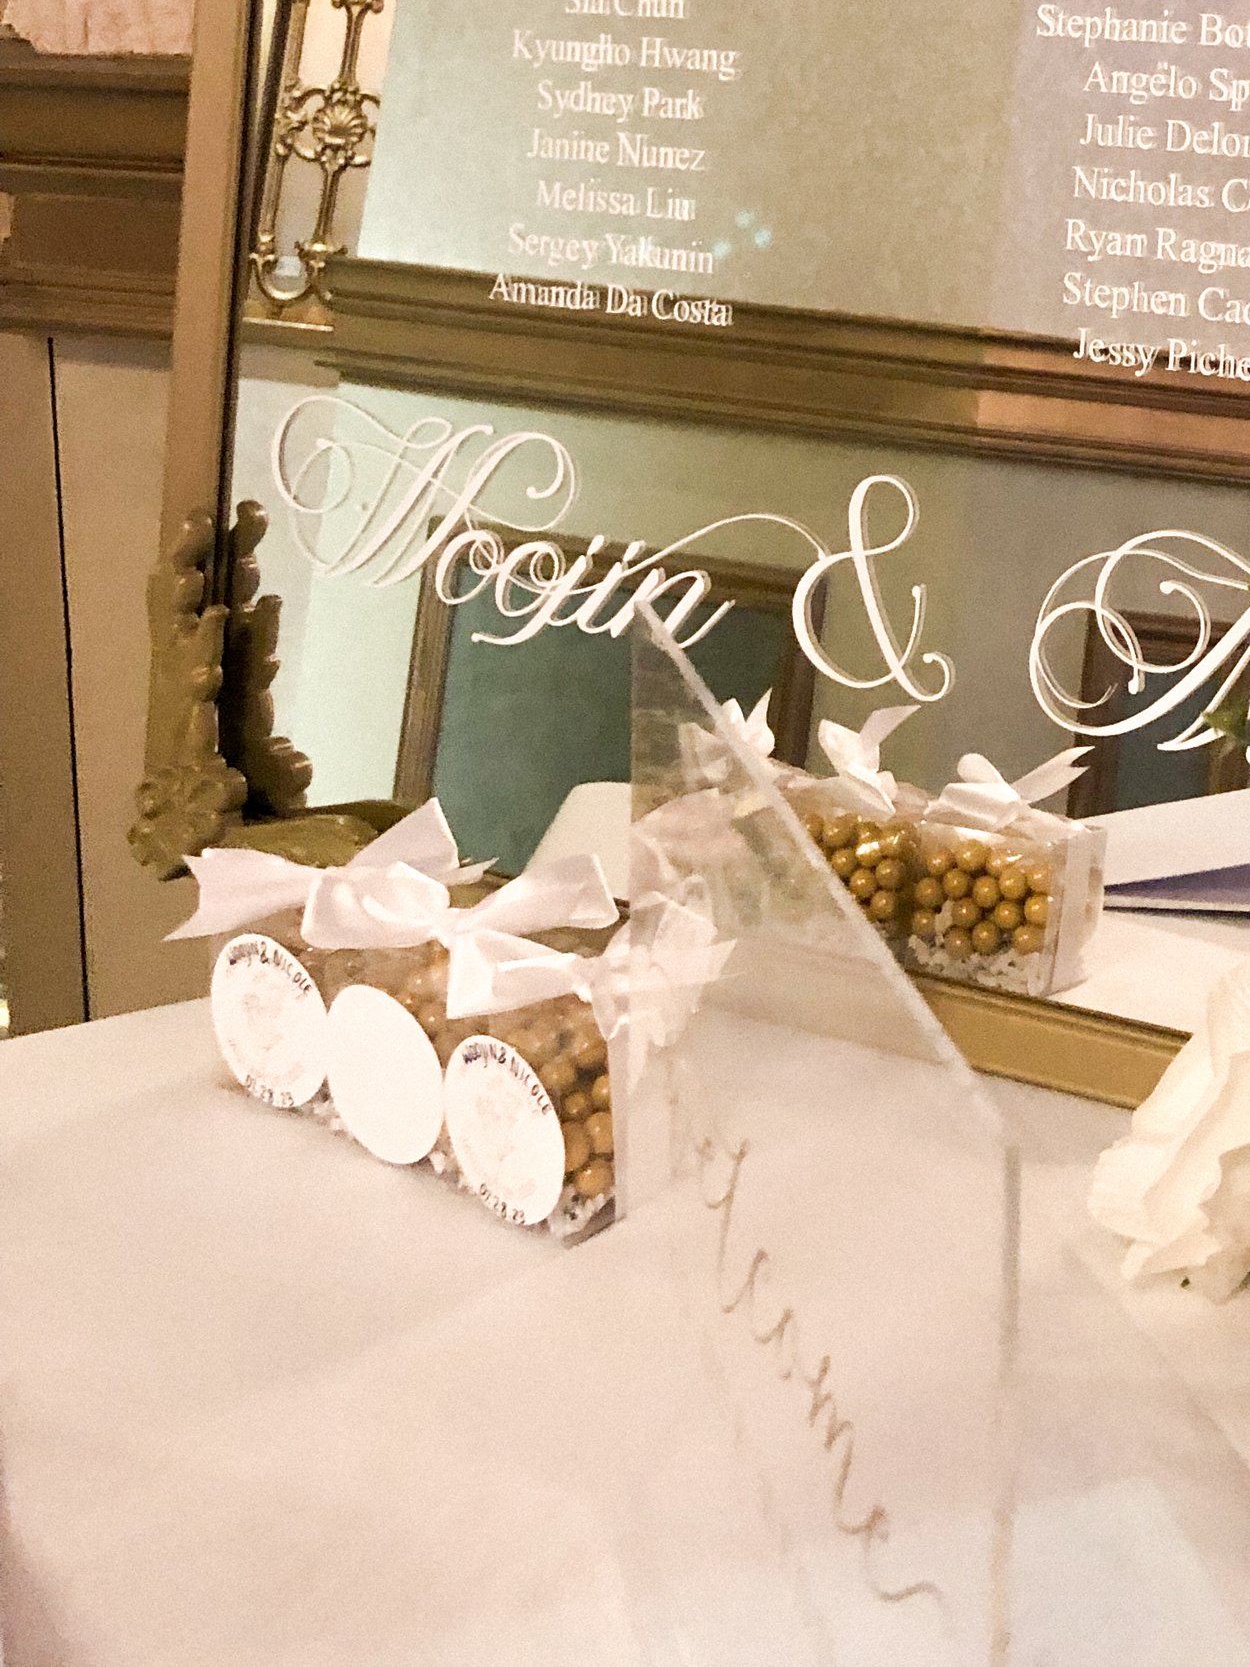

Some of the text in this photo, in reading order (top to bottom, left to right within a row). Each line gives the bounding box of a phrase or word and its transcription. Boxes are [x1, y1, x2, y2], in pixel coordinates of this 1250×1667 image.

[1036, 4, 1188, 48] Stephanie
[512, 29, 741, 82] Kyungho Hwang
[537, 79, 703, 124] Sydney Park
[1082, 61, 1199, 105] Angelo
[526, 128, 707, 172] Janine Nunez
[1079, 113, 1154, 150] Julie
[536, 179, 696, 222] Melissa Liu
[1072, 165, 1213, 209] Nicholas
[507, 223, 714, 275] Sergey Yakunin
[1064, 218, 1146, 261] Ryan
[489, 274, 735, 327] Amanda Da Costa
[1063, 272, 1188, 319] Stephen
[1072, 328, 1159, 377] Jessy
[791, 471, 954, 703] &
